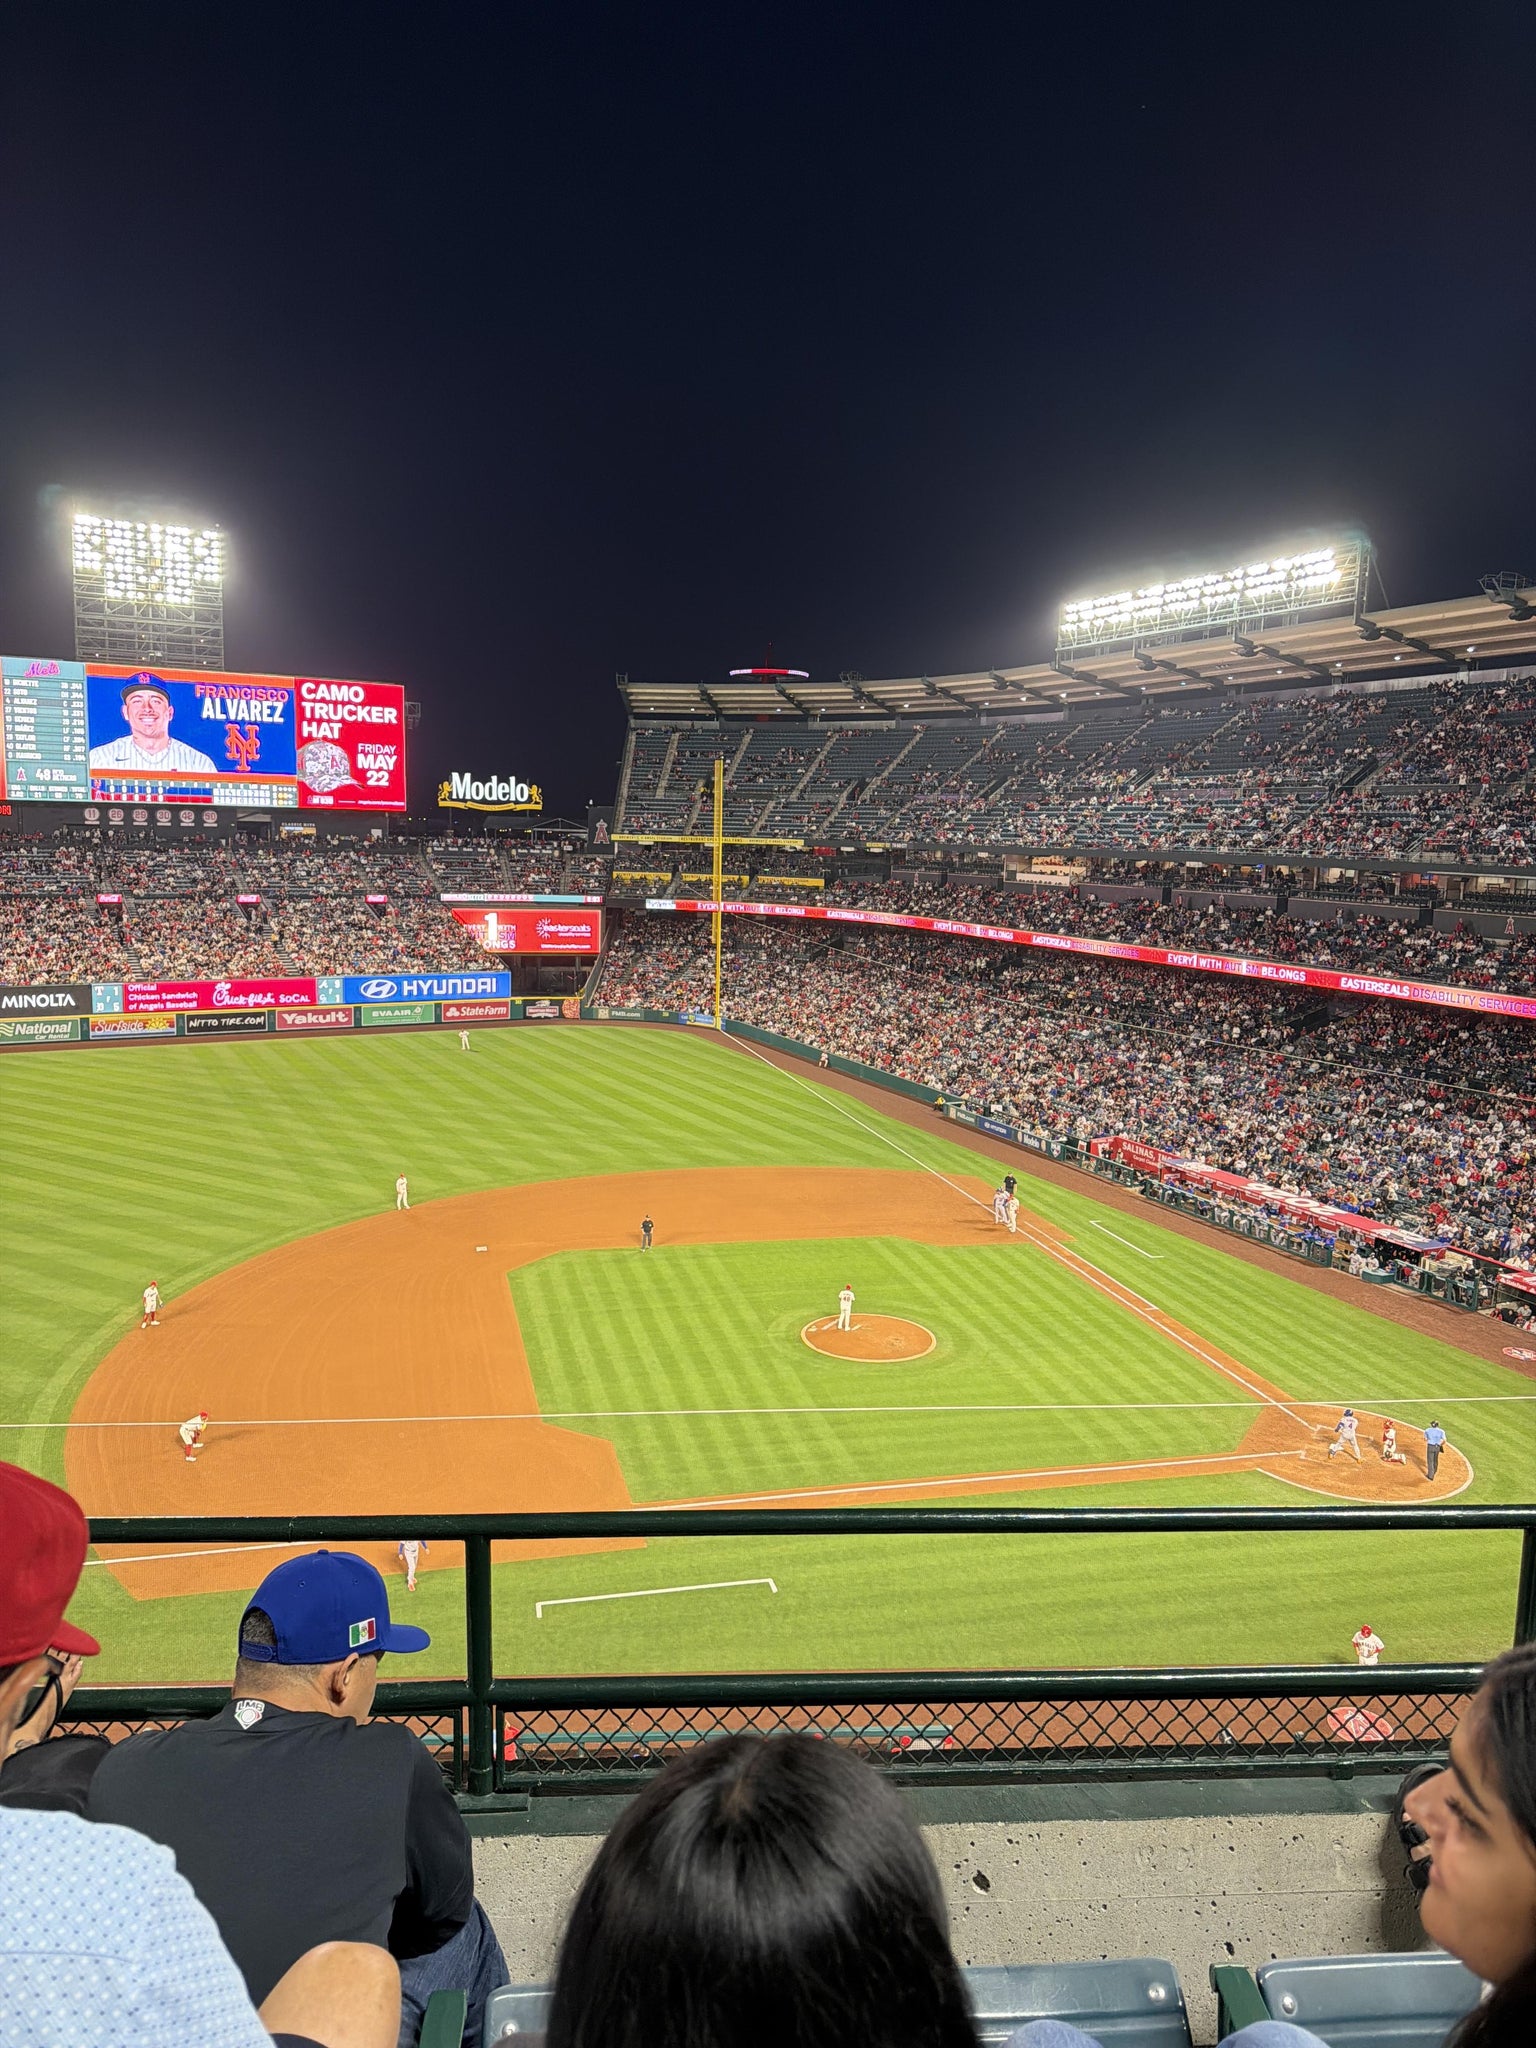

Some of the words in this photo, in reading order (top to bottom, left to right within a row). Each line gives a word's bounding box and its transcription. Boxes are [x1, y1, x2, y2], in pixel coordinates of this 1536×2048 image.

[24, 661, 60, 678] Mets
[195, 684, 289, 703] FRANCISCO
[302, 682, 364, 703] CAMO
[202, 698, 285, 723] ALVAREZ
[302, 702, 398, 724] TRUCKER
[302, 721, 342, 739] HAT
[358, 743, 396, 755] FRIDAY
[357, 754, 398, 770] MAY
[366, 771, 389, 786] 22
[451, 772, 529, 802] Modelo
[88, 810, 96, 818] 11
[181, 811, 193, 820] 42
[726, 904, 744, 912] WITH
[776, 906, 806, 915] BELONGS
[826, 910, 864, 920] EASTERSEALS
[988, 929, 1014, 940] BELONGS
[1032, 935, 1071, 948] EASTERSEALS
[1200, 958, 1222, 970] WITH
[1262, 966, 1306, 982] BELONGS
[128, 984, 156, 992] Official
[403, 978, 496, 996] HYUNDAI
[2, 994, 76, 1008] MINOLTA
[162, 992, 198, 1000] Sandwich
[1340, 977, 1410, 997] EASTERSEALS
[1412, 987, 1476, 1006] DISABILITY
[1479, 997, 1536, 1015] SERVICES
[138, 1002, 164, 1011] Angels
[166, 1000, 198, 1009] Baseball
[189, 1017, 218, 1028] NITTO
[220, 1016, 265, 1026] TIRE.COM
[282, 1012, 349, 1024] Yakult
[14, 1022, 72, 1035] National
[94, 1020, 144, 1033] Surfside
[1122, 1142, 1156, 1160] SALINAS,
[237, 1700, 264, 1712] LMB
